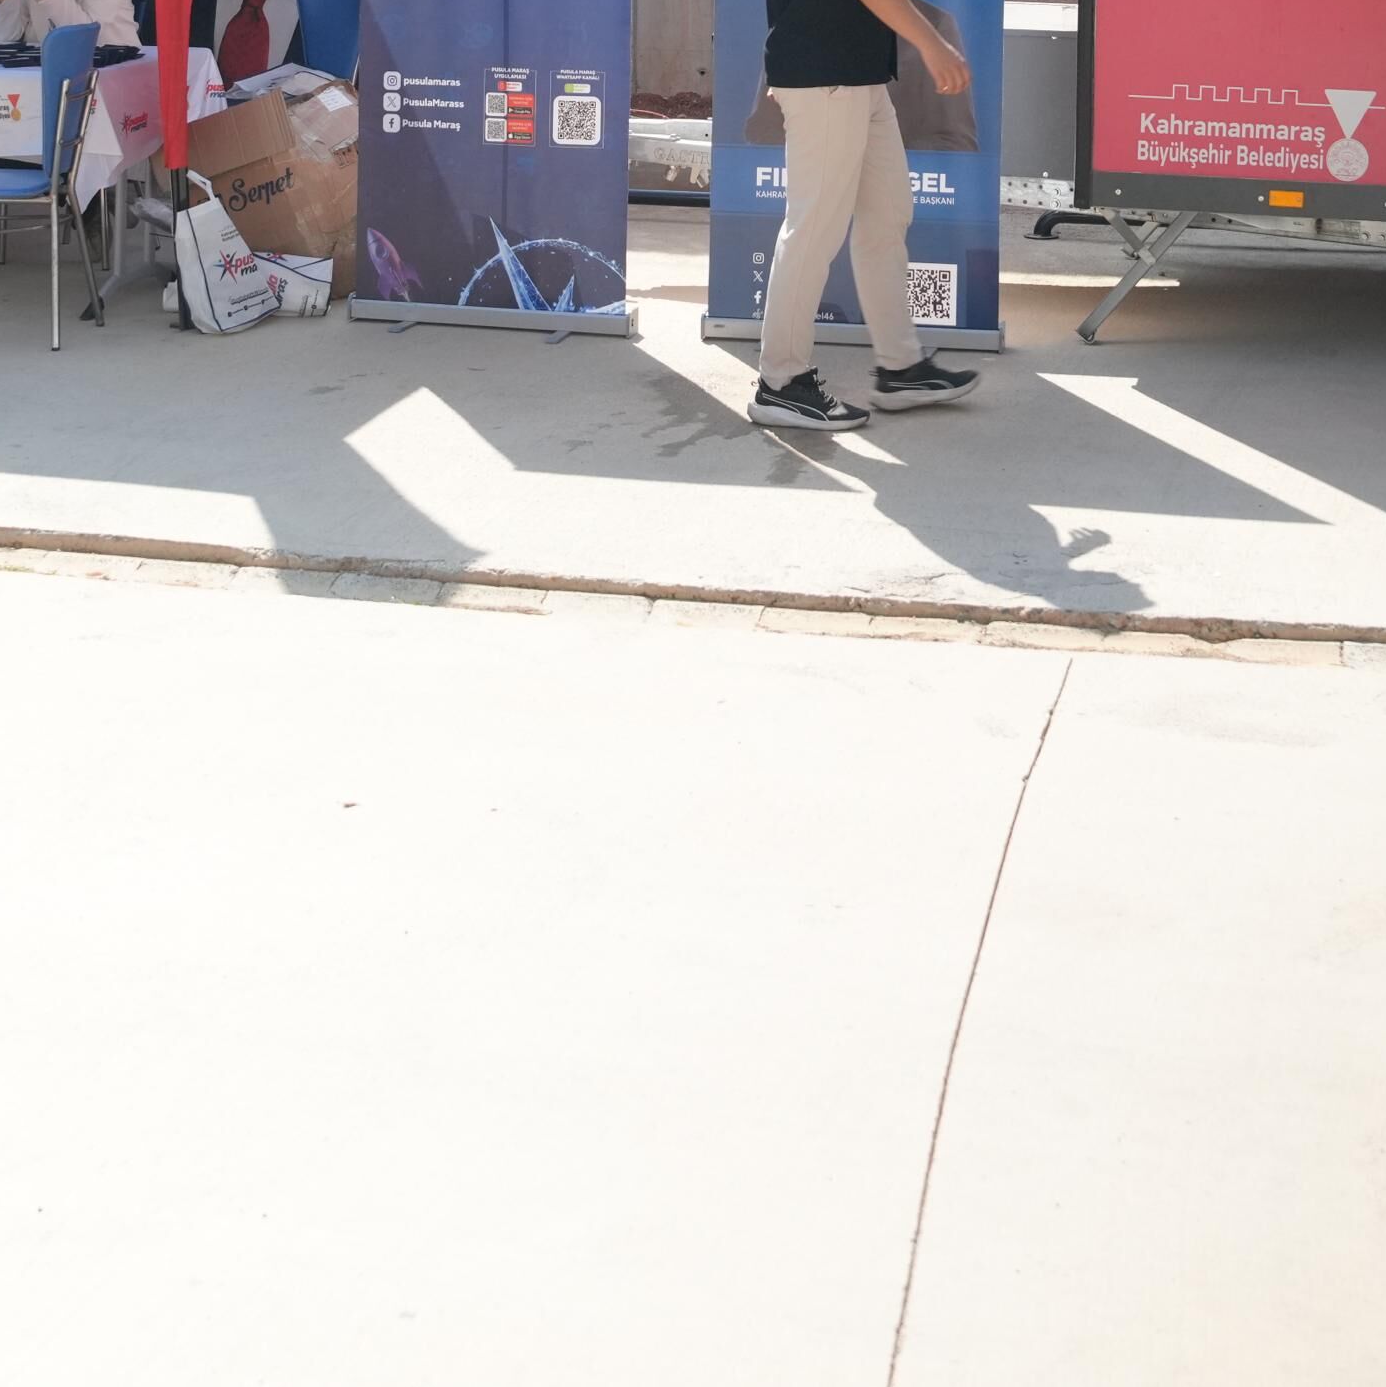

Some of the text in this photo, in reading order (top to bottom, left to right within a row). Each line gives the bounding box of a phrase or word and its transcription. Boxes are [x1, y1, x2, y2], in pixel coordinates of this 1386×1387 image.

[403, 76, 461, 87] pusulamaras
[403, 98, 465, 108] PusulaMarass
[402, 119, 461, 132] Pusula Maraş
[1140, 113, 1325, 147] Kahramanmaraş
[1137, 140, 1324, 173] Büyükşehir Belediyesi
[228, 167, 295, 212] Serpet
[920, 196, 955, 206] BAŞKANI
